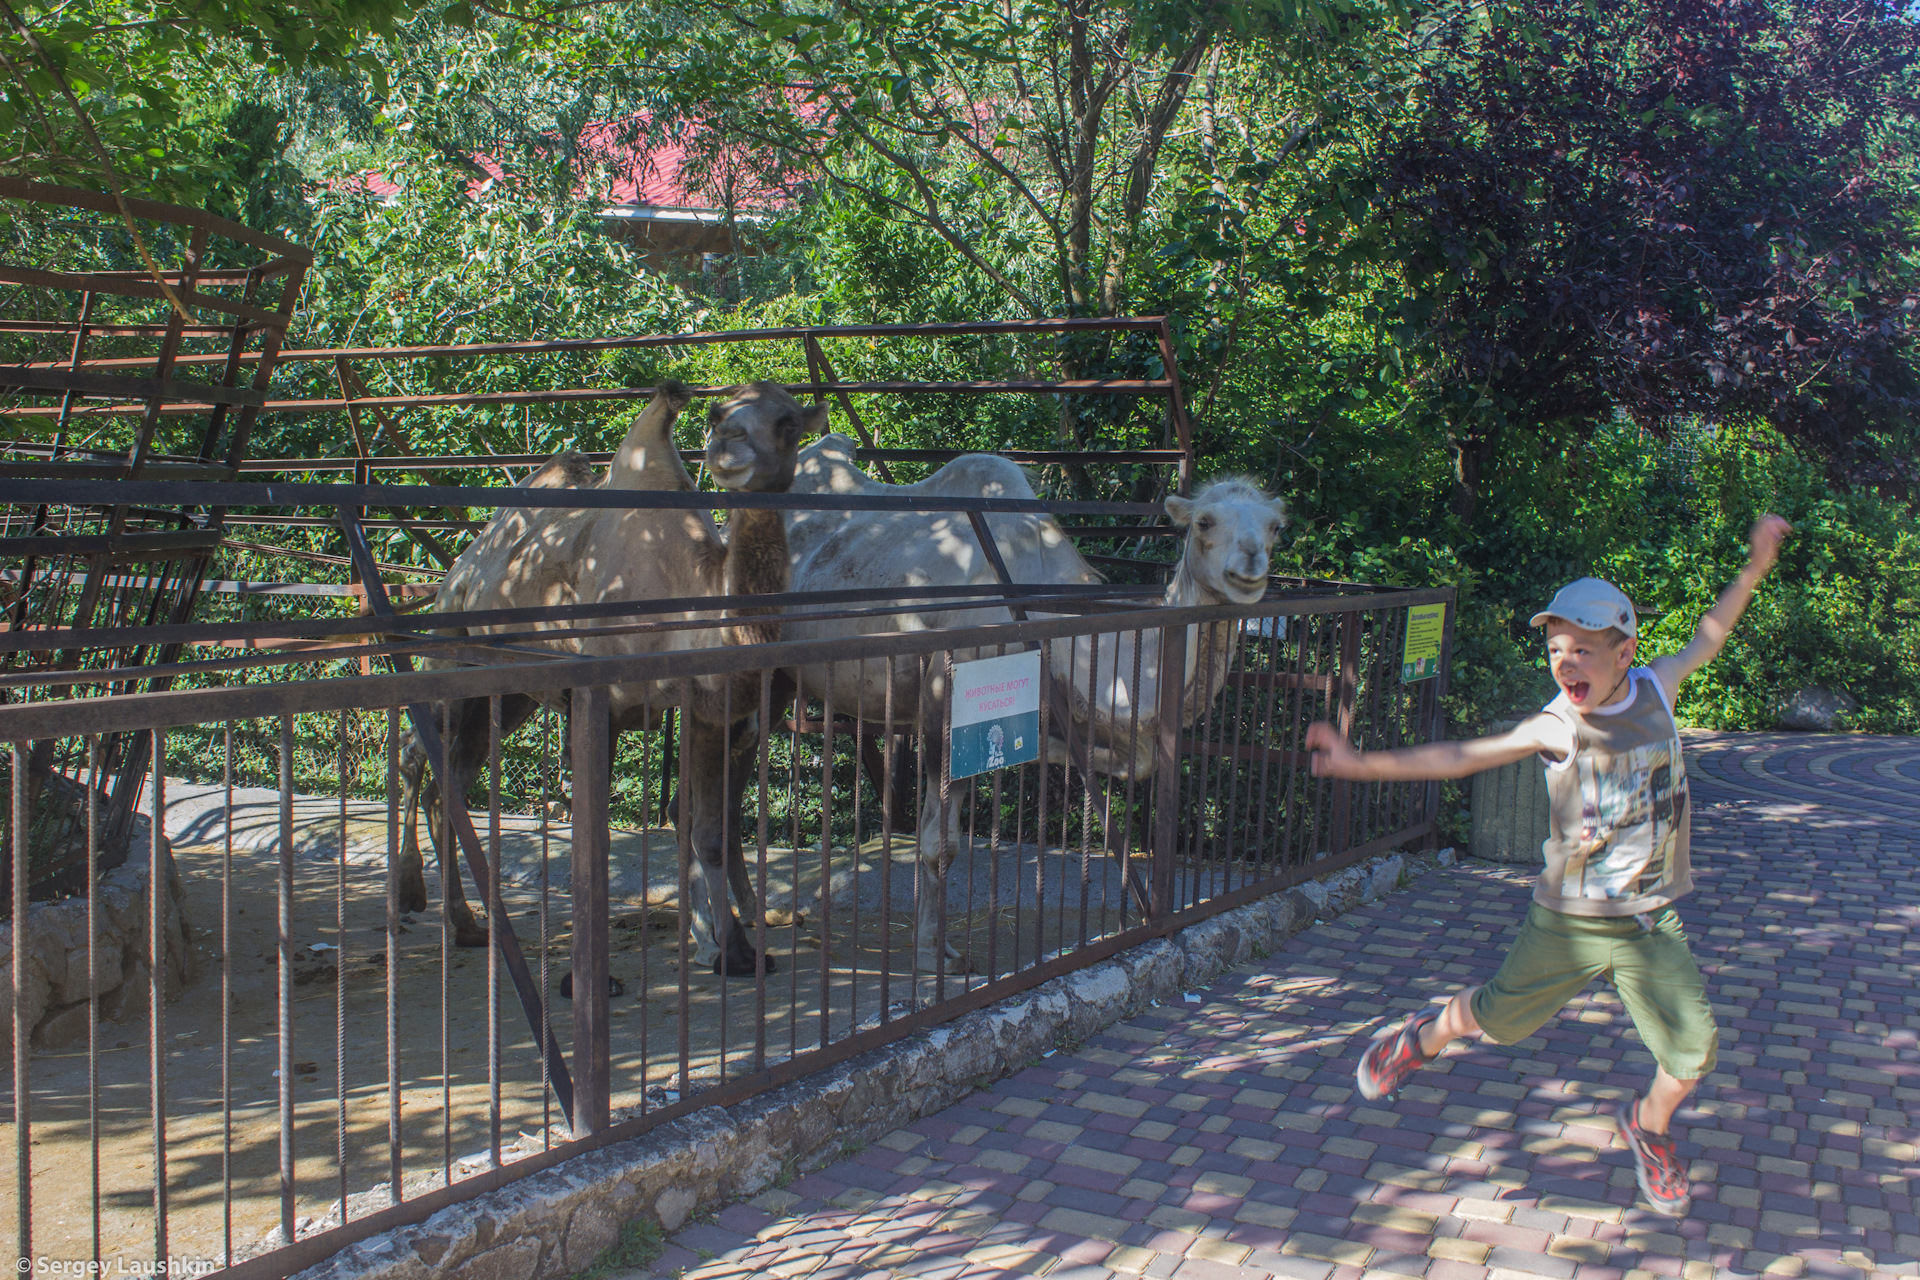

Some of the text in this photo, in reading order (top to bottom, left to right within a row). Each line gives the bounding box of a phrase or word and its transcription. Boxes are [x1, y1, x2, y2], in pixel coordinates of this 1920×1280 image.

[965, 678, 1029, 699] ЖИВОТНЫЕ МОГУТ
[979, 696, 1015, 712] КУСАТЬСЯ!
